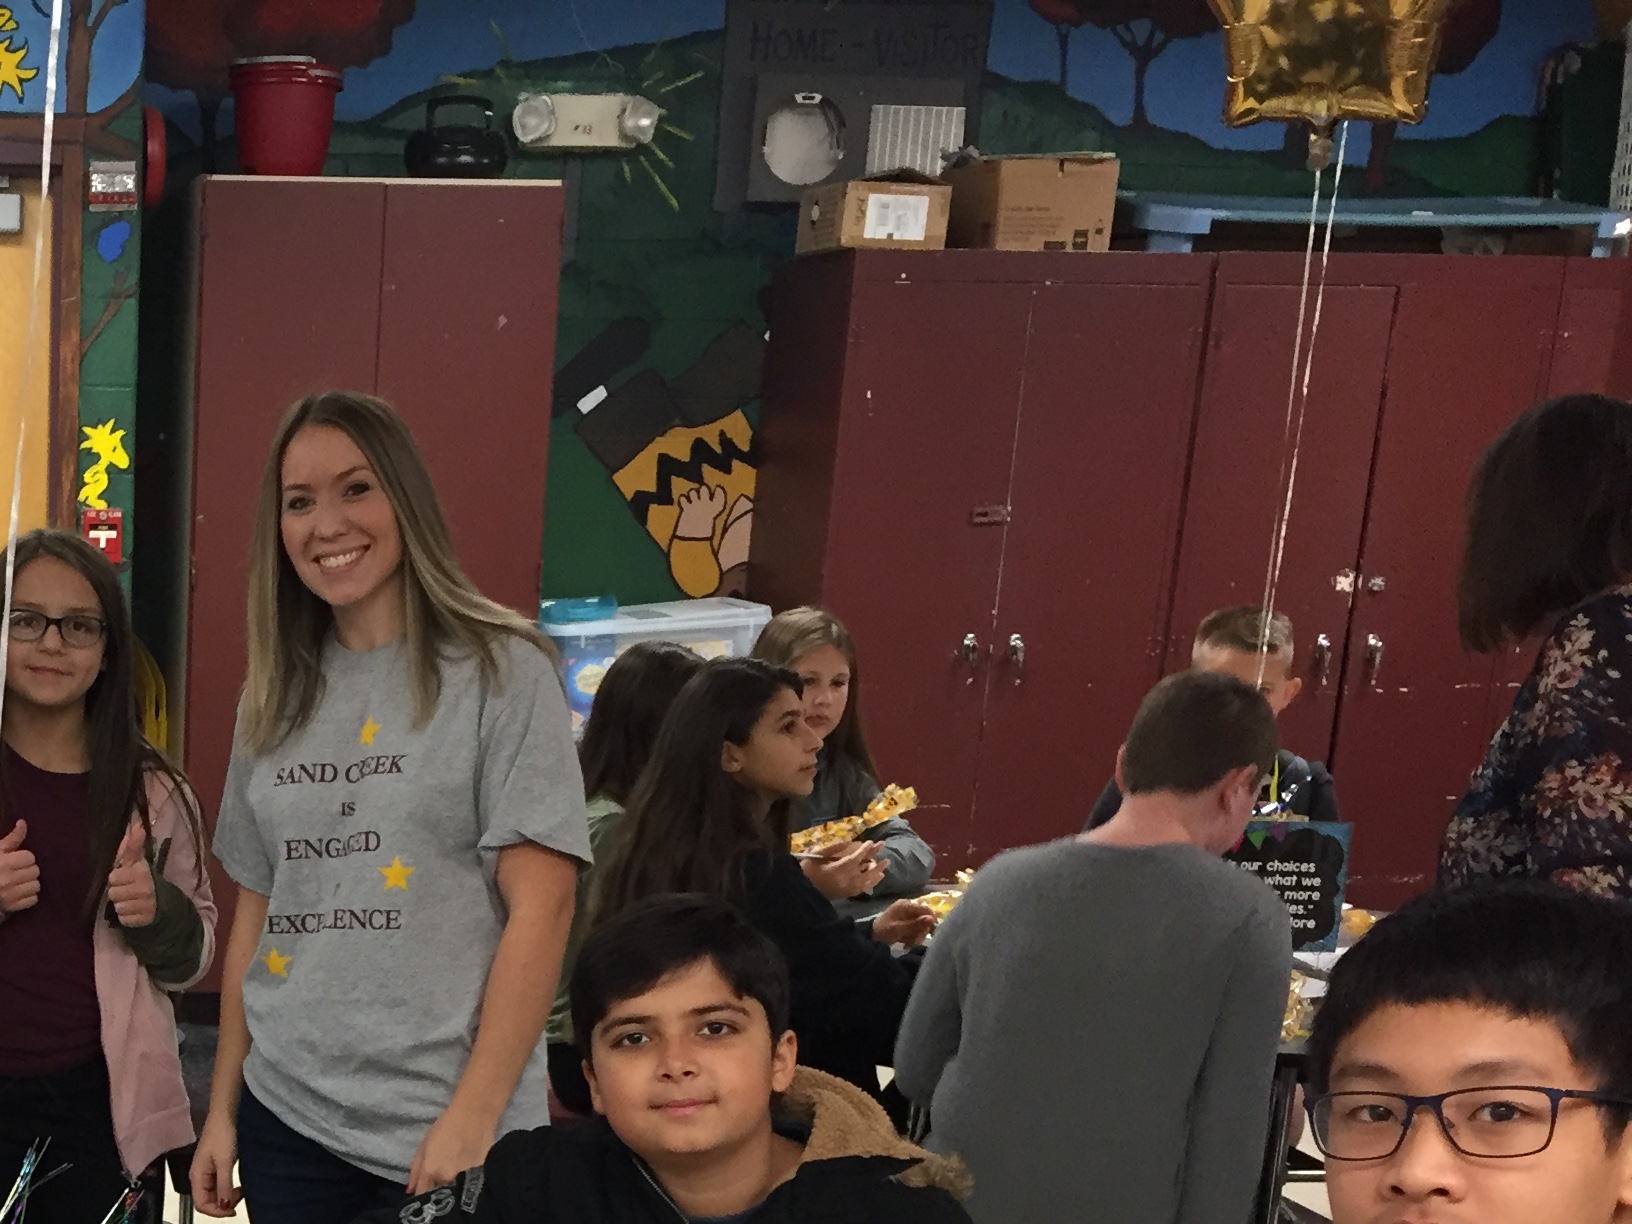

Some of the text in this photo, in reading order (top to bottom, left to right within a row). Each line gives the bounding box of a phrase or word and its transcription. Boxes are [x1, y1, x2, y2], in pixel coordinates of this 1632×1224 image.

[749, 22, 839, 63] HOME
[273, 762, 339, 787] SAND
[341, 801, 356, 817] IS
[1240, 861, 1263, 871] our
[1266, 859, 1317, 873] choices
[1263, 874, 1322, 887] what we
[1283, 890, 1321, 901] more
